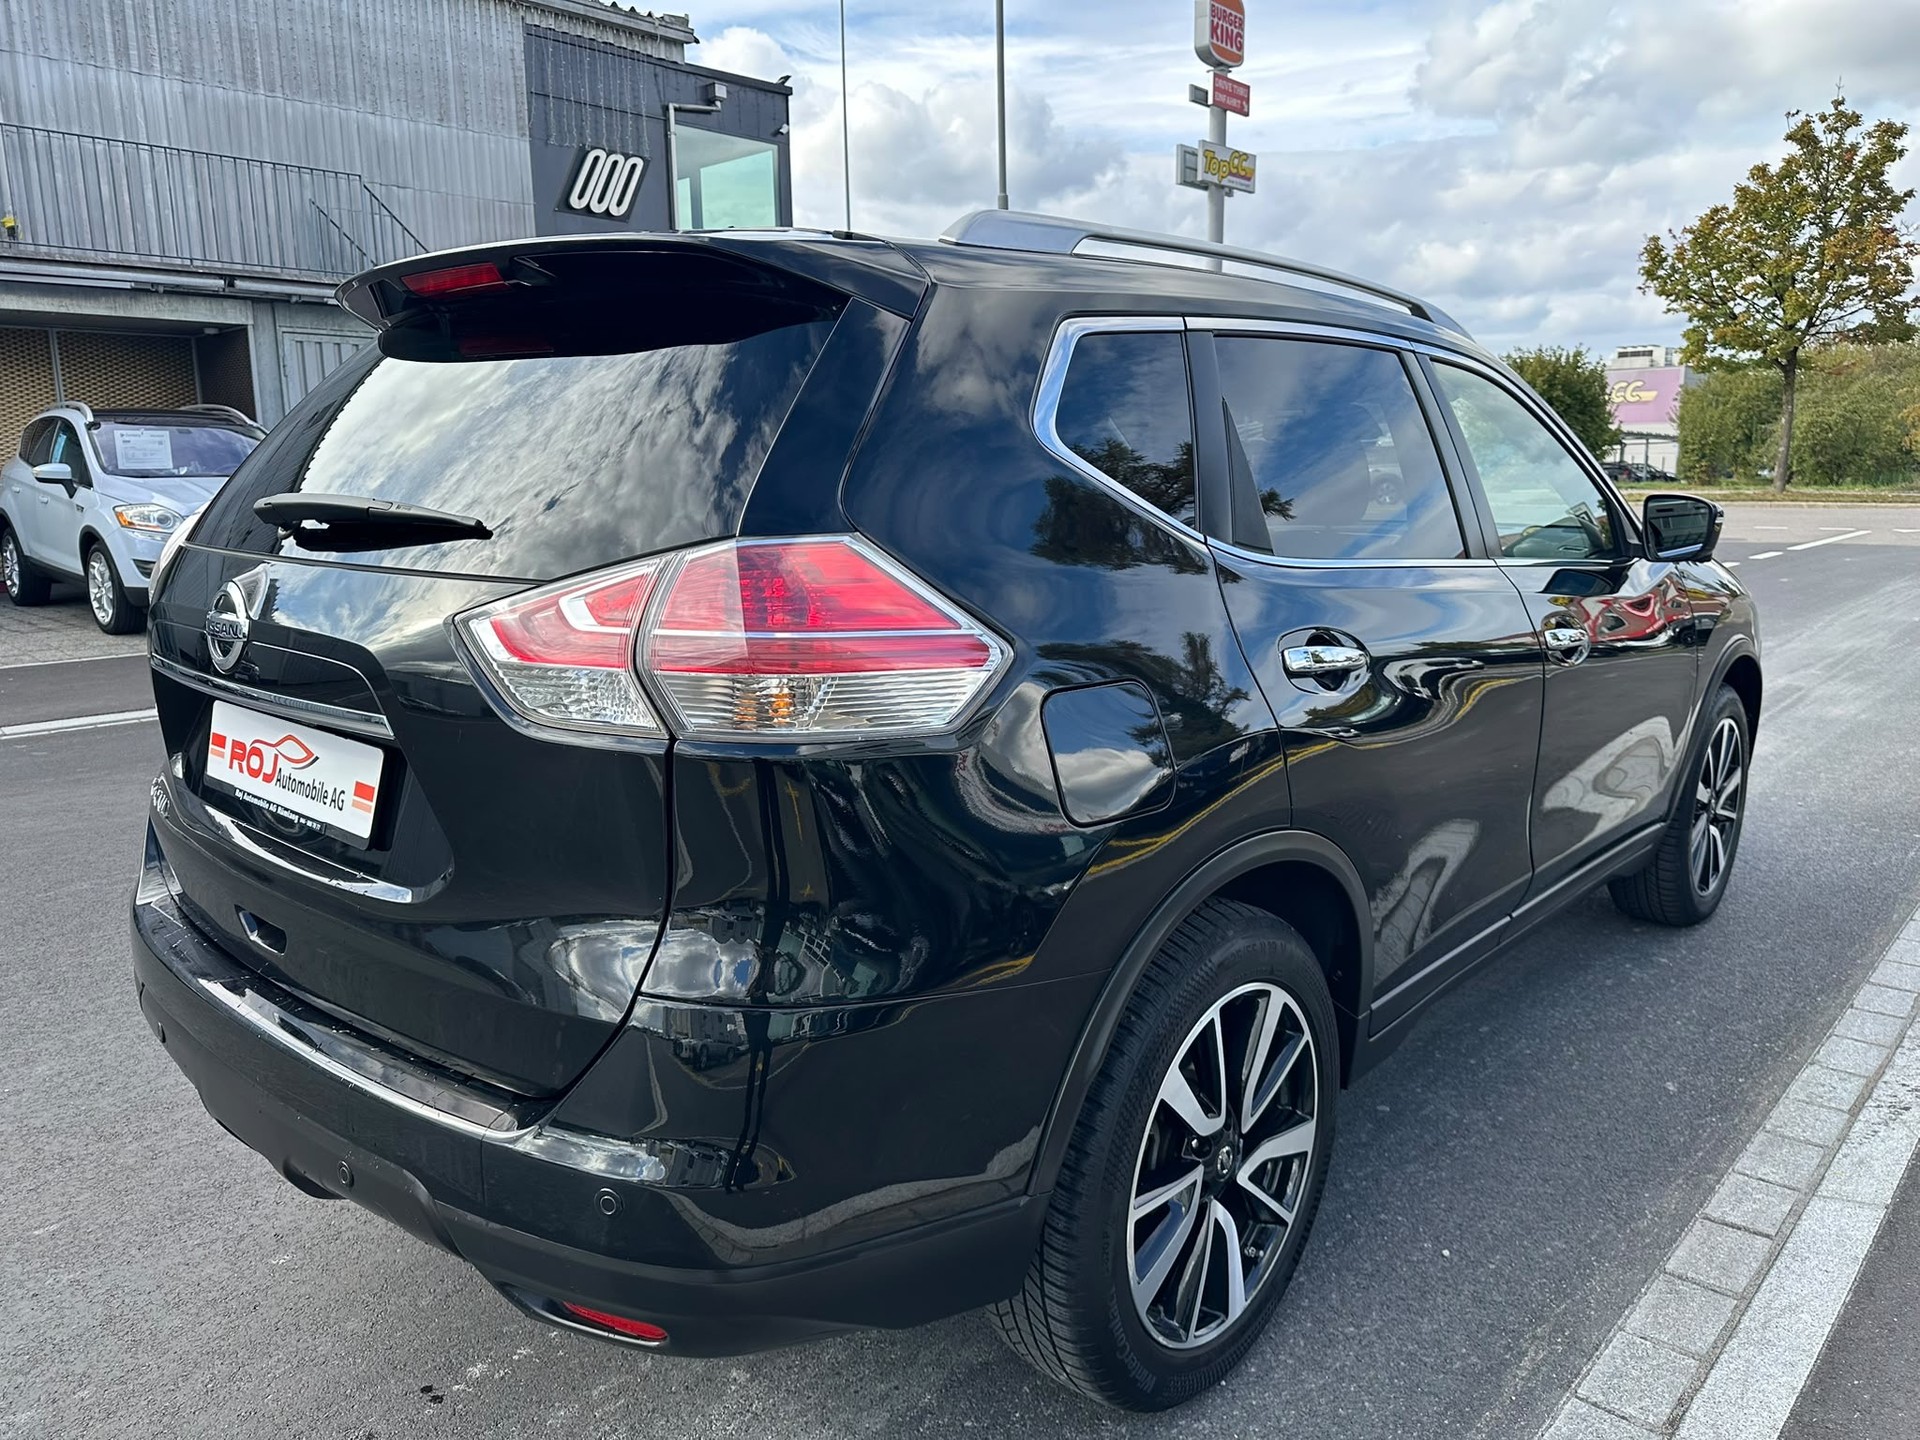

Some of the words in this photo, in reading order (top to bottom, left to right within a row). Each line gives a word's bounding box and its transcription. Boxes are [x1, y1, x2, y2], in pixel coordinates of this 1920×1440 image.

[1210, 3, 1243, 30] BURGER
[1210, 19, 1243, 52] KING
[207, 620, 244, 639] SSAN
[228, 738, 279, 784] ROJ
[274, 767, 329, 806] Automobile
[328, 787, 346, 812] AG
